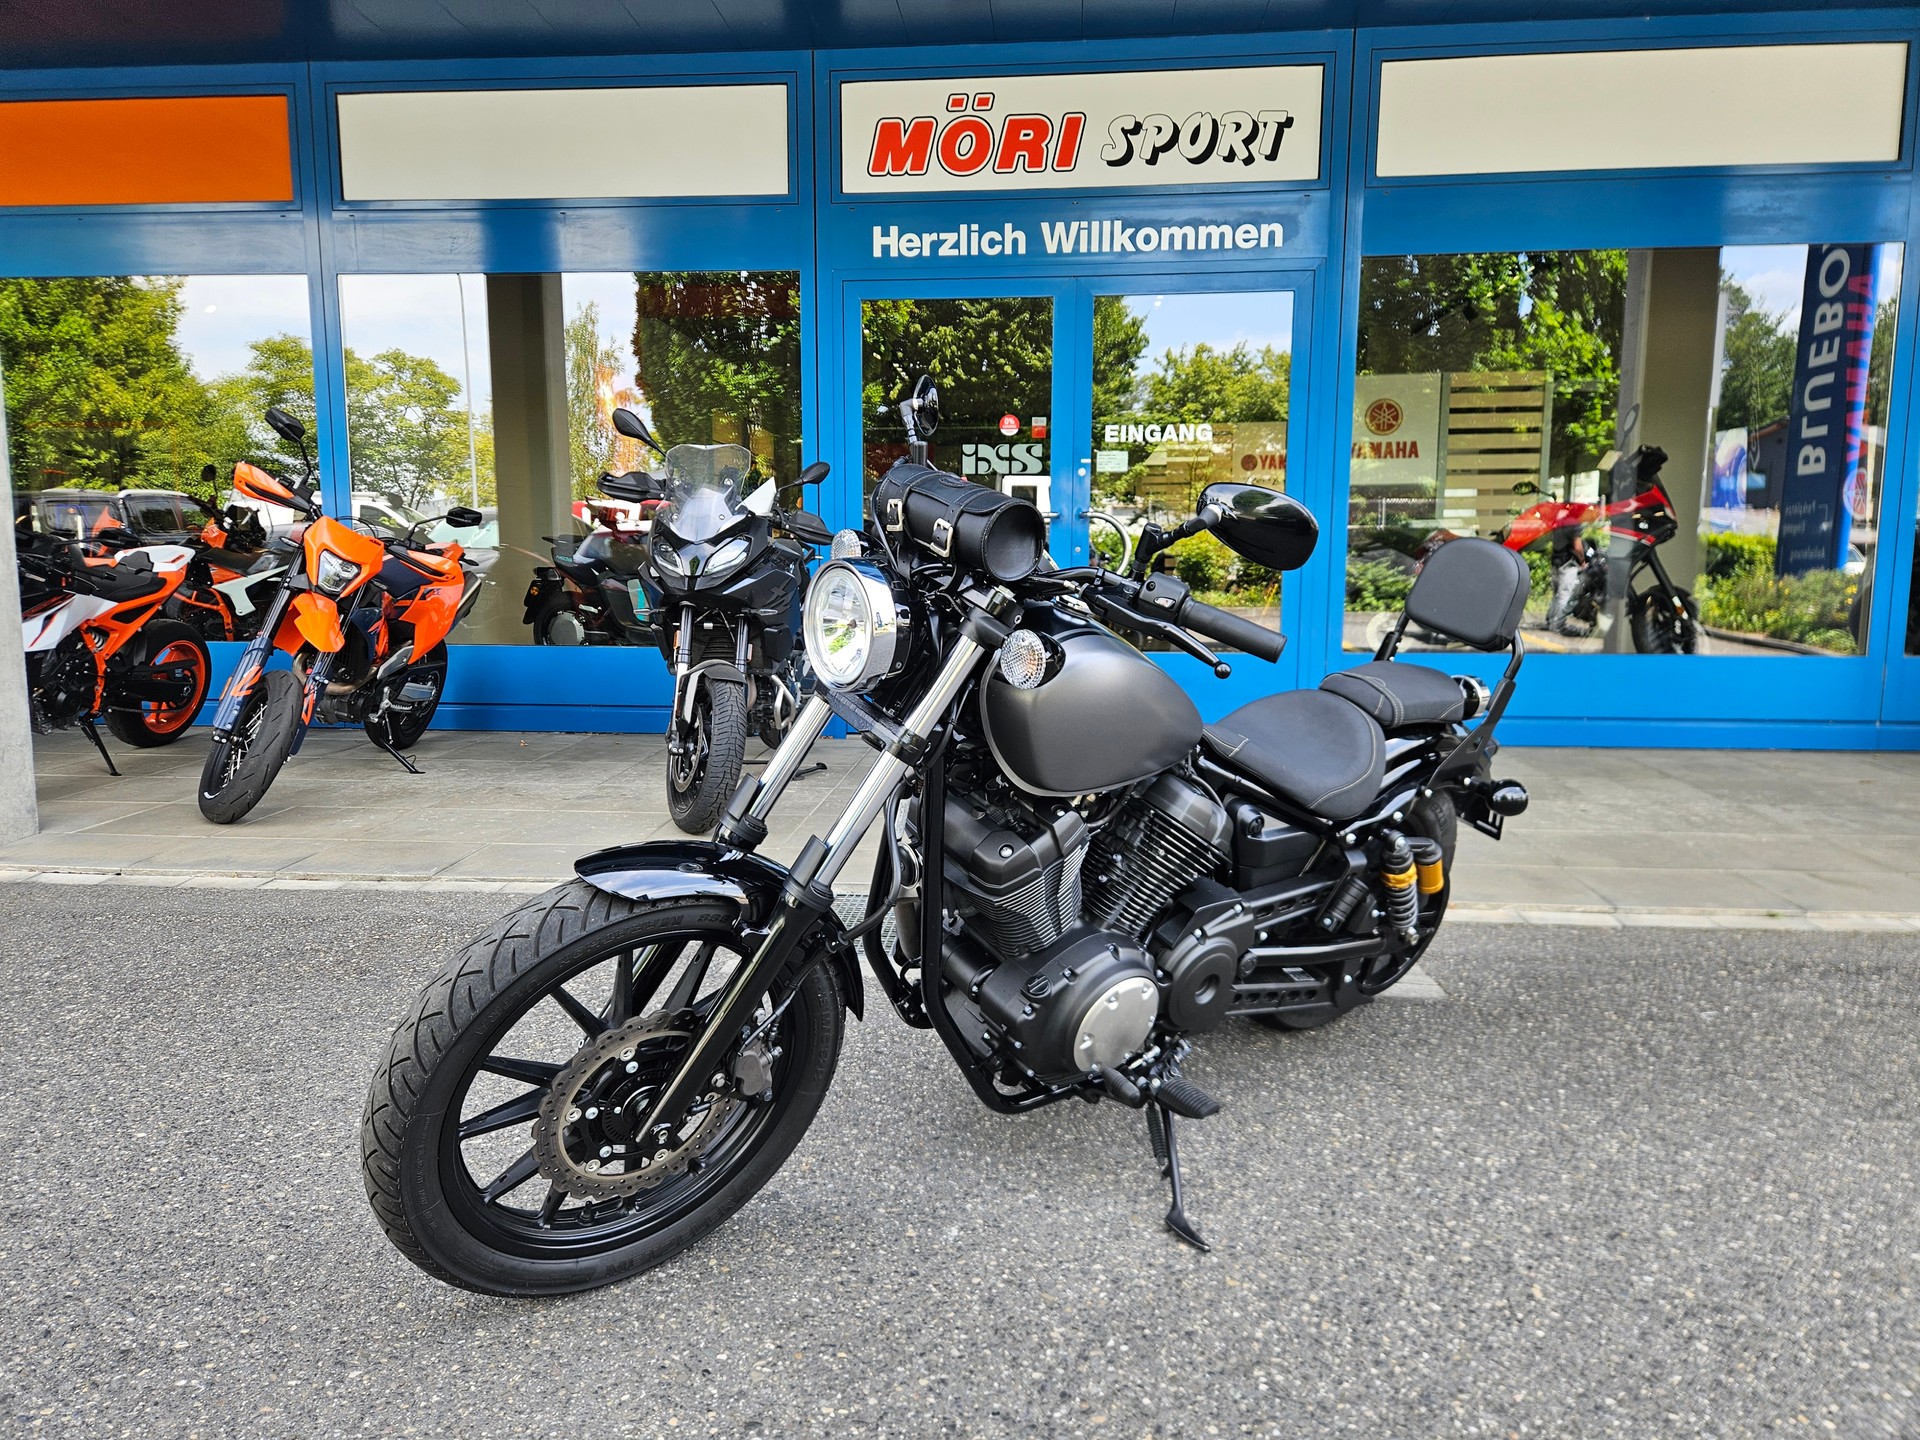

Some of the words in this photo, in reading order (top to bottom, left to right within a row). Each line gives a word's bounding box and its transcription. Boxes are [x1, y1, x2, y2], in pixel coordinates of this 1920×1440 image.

[867, 92, 1087, 177] MÖRI
[1100, 110, 1295, 167] SPORT
[872, 222, 1026, 257] Herzlich
[1041, 219, 1284, 255] Willkommen
[1104, 424, 1213, 443] EINGANG
